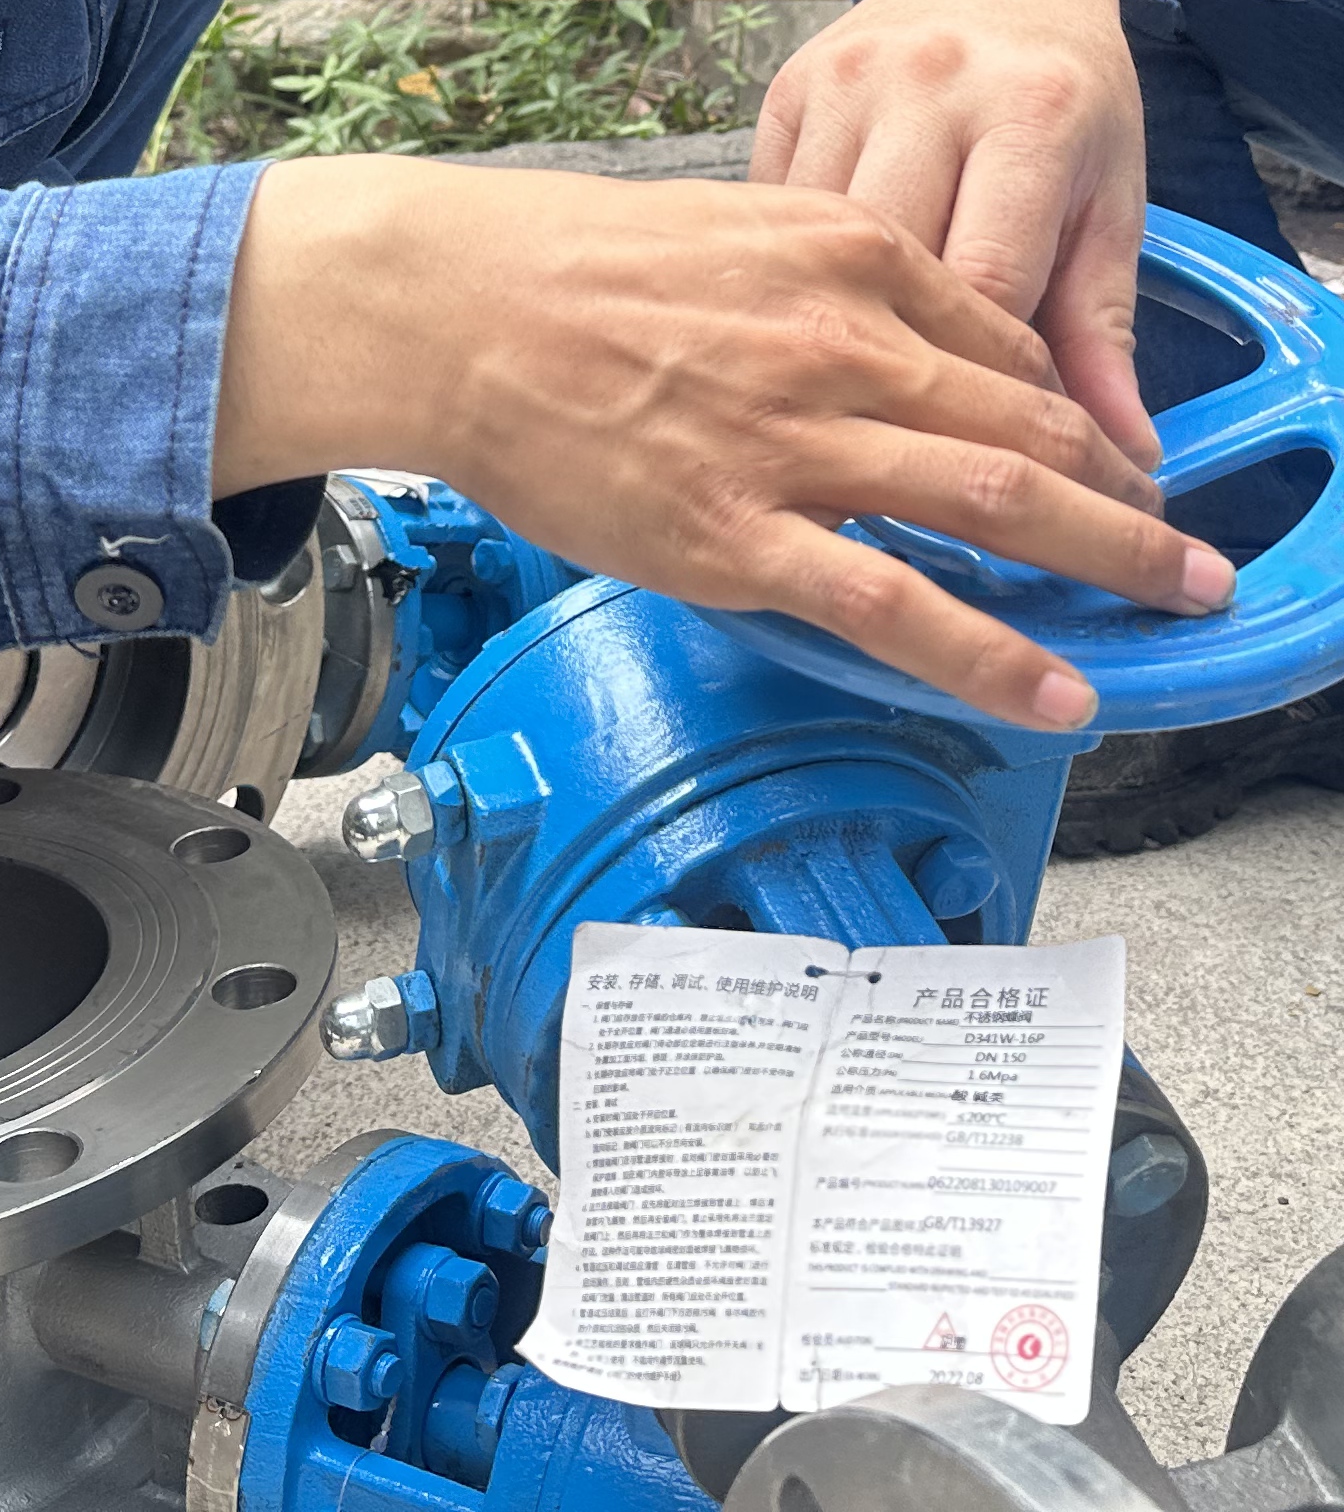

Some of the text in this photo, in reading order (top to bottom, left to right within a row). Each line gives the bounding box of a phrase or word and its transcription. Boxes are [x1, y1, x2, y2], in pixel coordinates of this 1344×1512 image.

[912, 987, 1051, 1009] 产品合格证
[964, 1033, 1045, 1044] D341W-16P
[975, 1051, 998, 1063] DN
[1002, 1052, 1027, 1063] 150
